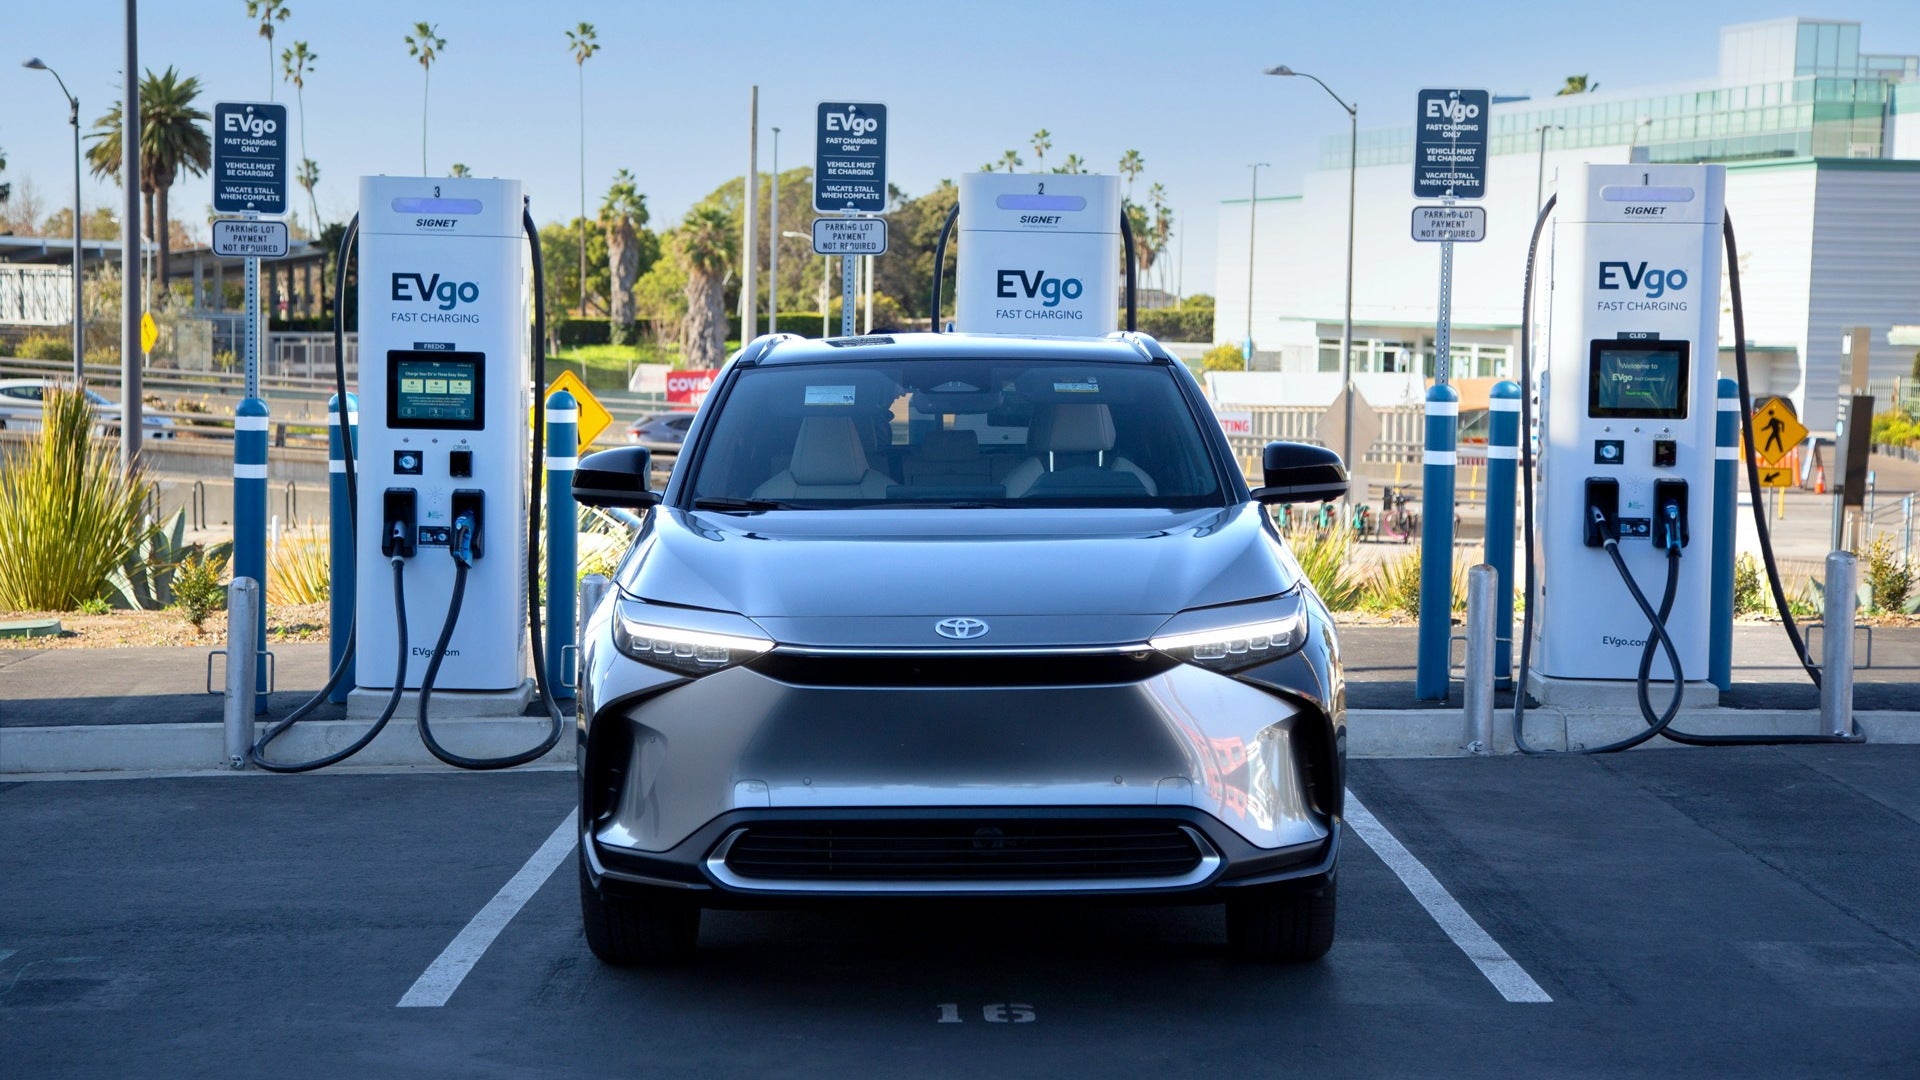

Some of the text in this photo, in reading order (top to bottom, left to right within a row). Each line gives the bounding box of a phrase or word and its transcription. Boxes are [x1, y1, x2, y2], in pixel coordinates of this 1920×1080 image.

[1427, 99, 1479, 123] EVgo
[224, 113, 276, 137] EVgo
[827, 112, 877, 136] EVgo
[1643, 173, 1648, 185] 1
[435, 186, 440, 198] 3
[1039, 183, 1044, 194] 2
[416, 219, 458, 227] SIGNET
[1020, 215, 1061, 224] SIGNET
[226, 225, 274, 234] PARKING LOT
[825, 223, 856, 231] PARKING
[233, 235, 267, 243] PAYMENT
[1599, 262, 1688, 298] EVgo
[392, 273, 479, 310] EVgo
[997, 270, 1083, 307] EVgo
[1598, 302, 1687, 311] FAST CHARGING
[392, 313, 479, 323] FAST CHARGING
[996, 310, 1082, 319] FAST CHARGING
[1612, 374, 1632, 382] EVgo
[413, 648, 459, 658] EVgoom
[937, 1004, 1036, 1023] 16
